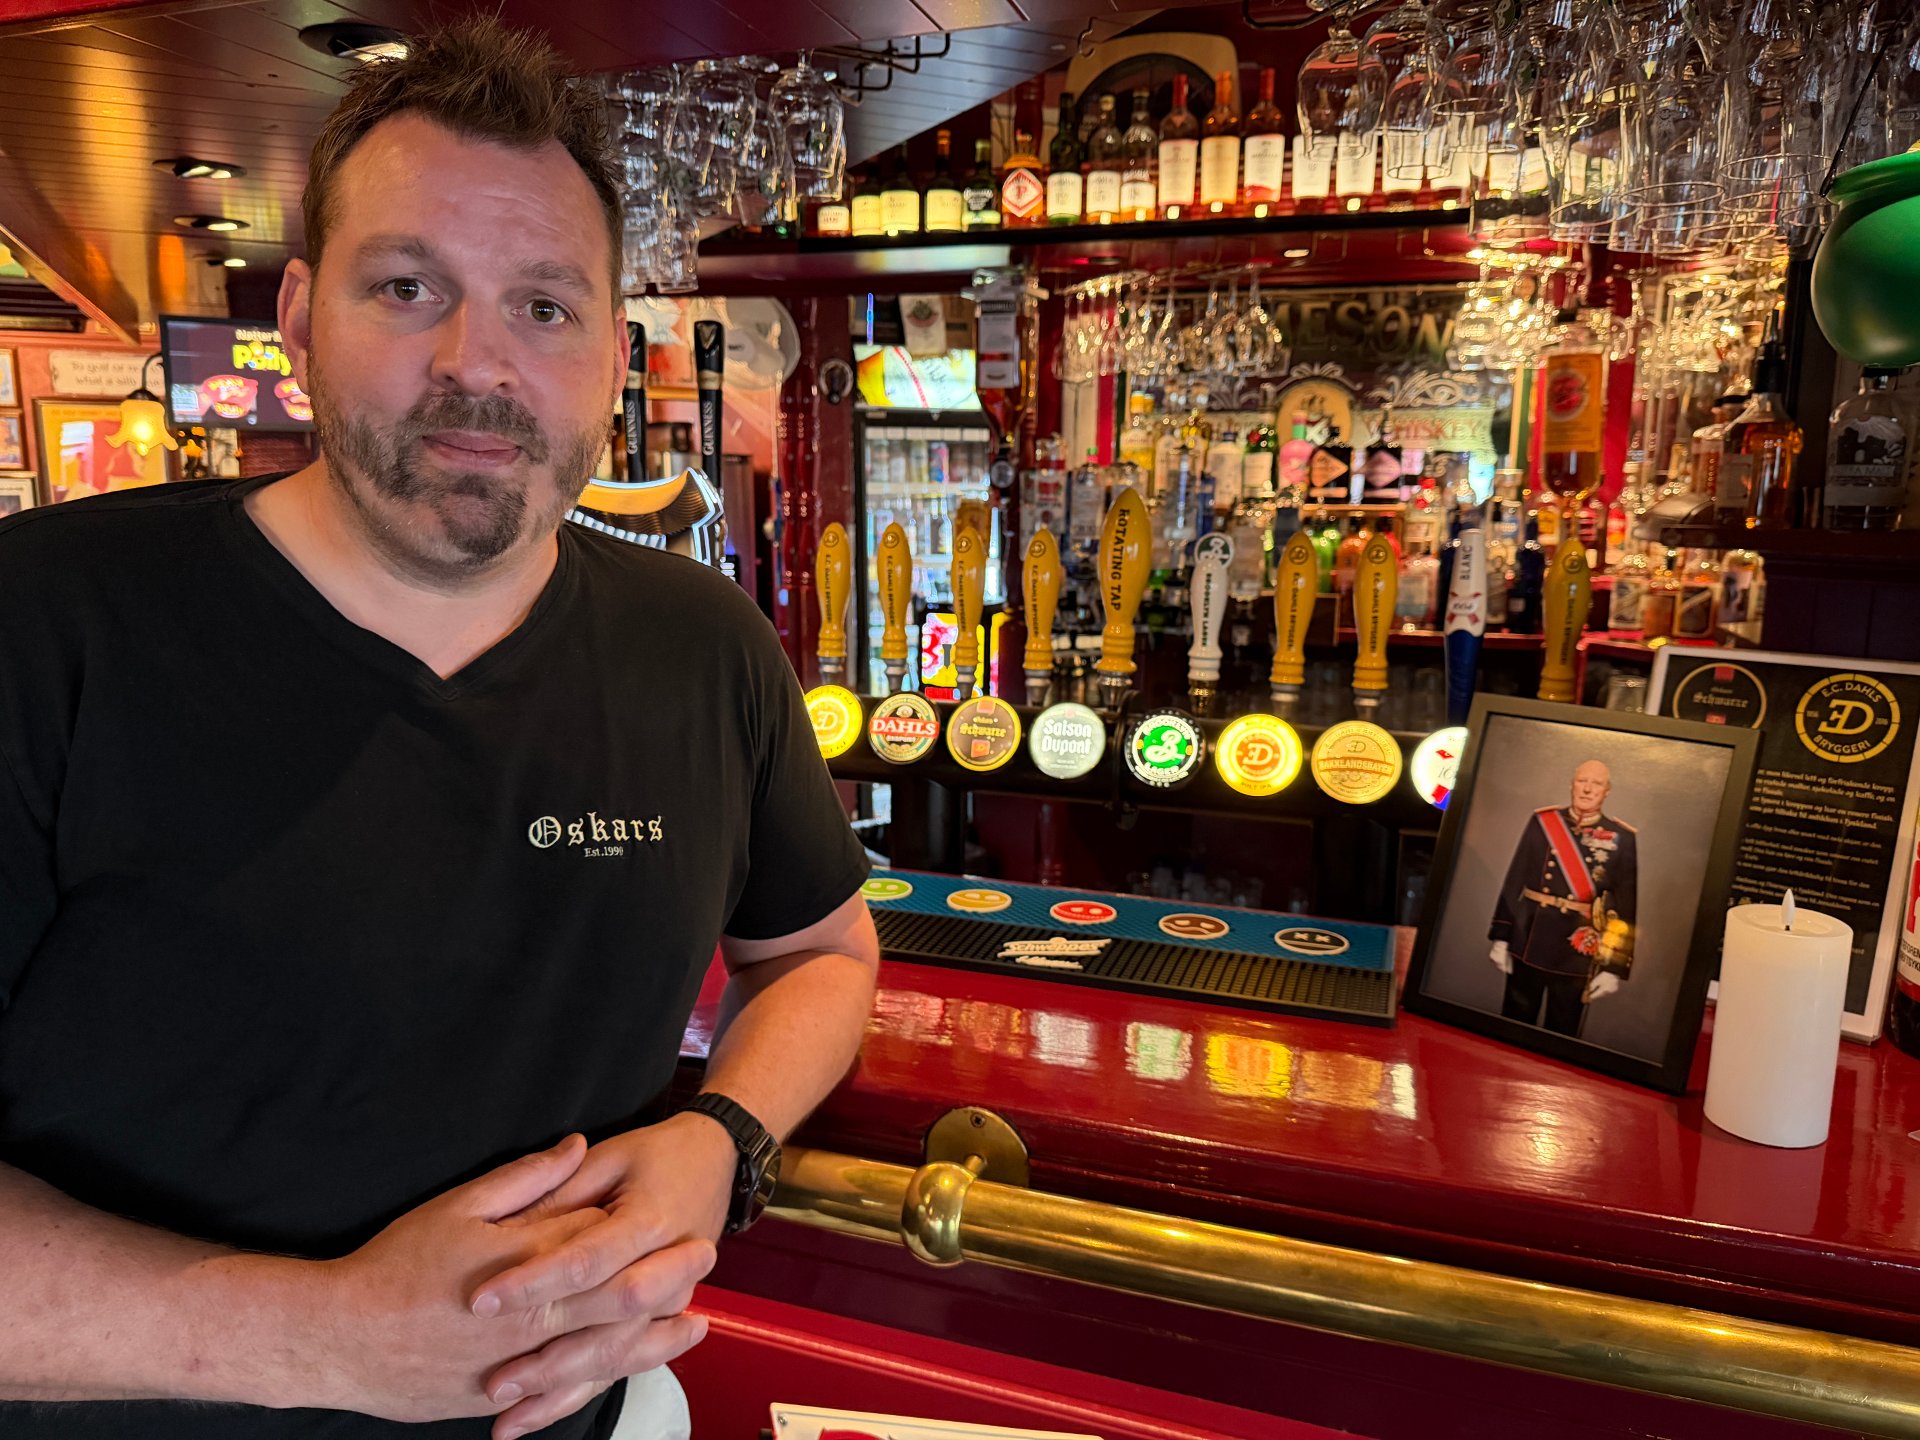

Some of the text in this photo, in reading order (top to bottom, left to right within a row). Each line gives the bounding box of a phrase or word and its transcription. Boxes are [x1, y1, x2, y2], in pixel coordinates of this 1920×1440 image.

[626, 400, 638, 454] GUINNESS
[702, 401, 714, 455] GUINNESS
[1110, 508, 1131, 611] ROTATING TAP
[1459, 544, 1473, 581] BLANC
[1820, 682, 1882, 703] E.C. DAHLS
[872, 718, 937, 736] DAHLS
[1042, 718, 1093, 738] Saison
[1041, 735, 1093, 756] Dupont
[1812, 734, 1872, 754] BRYGGERI
[528, 812, 664, 849] Oskars
